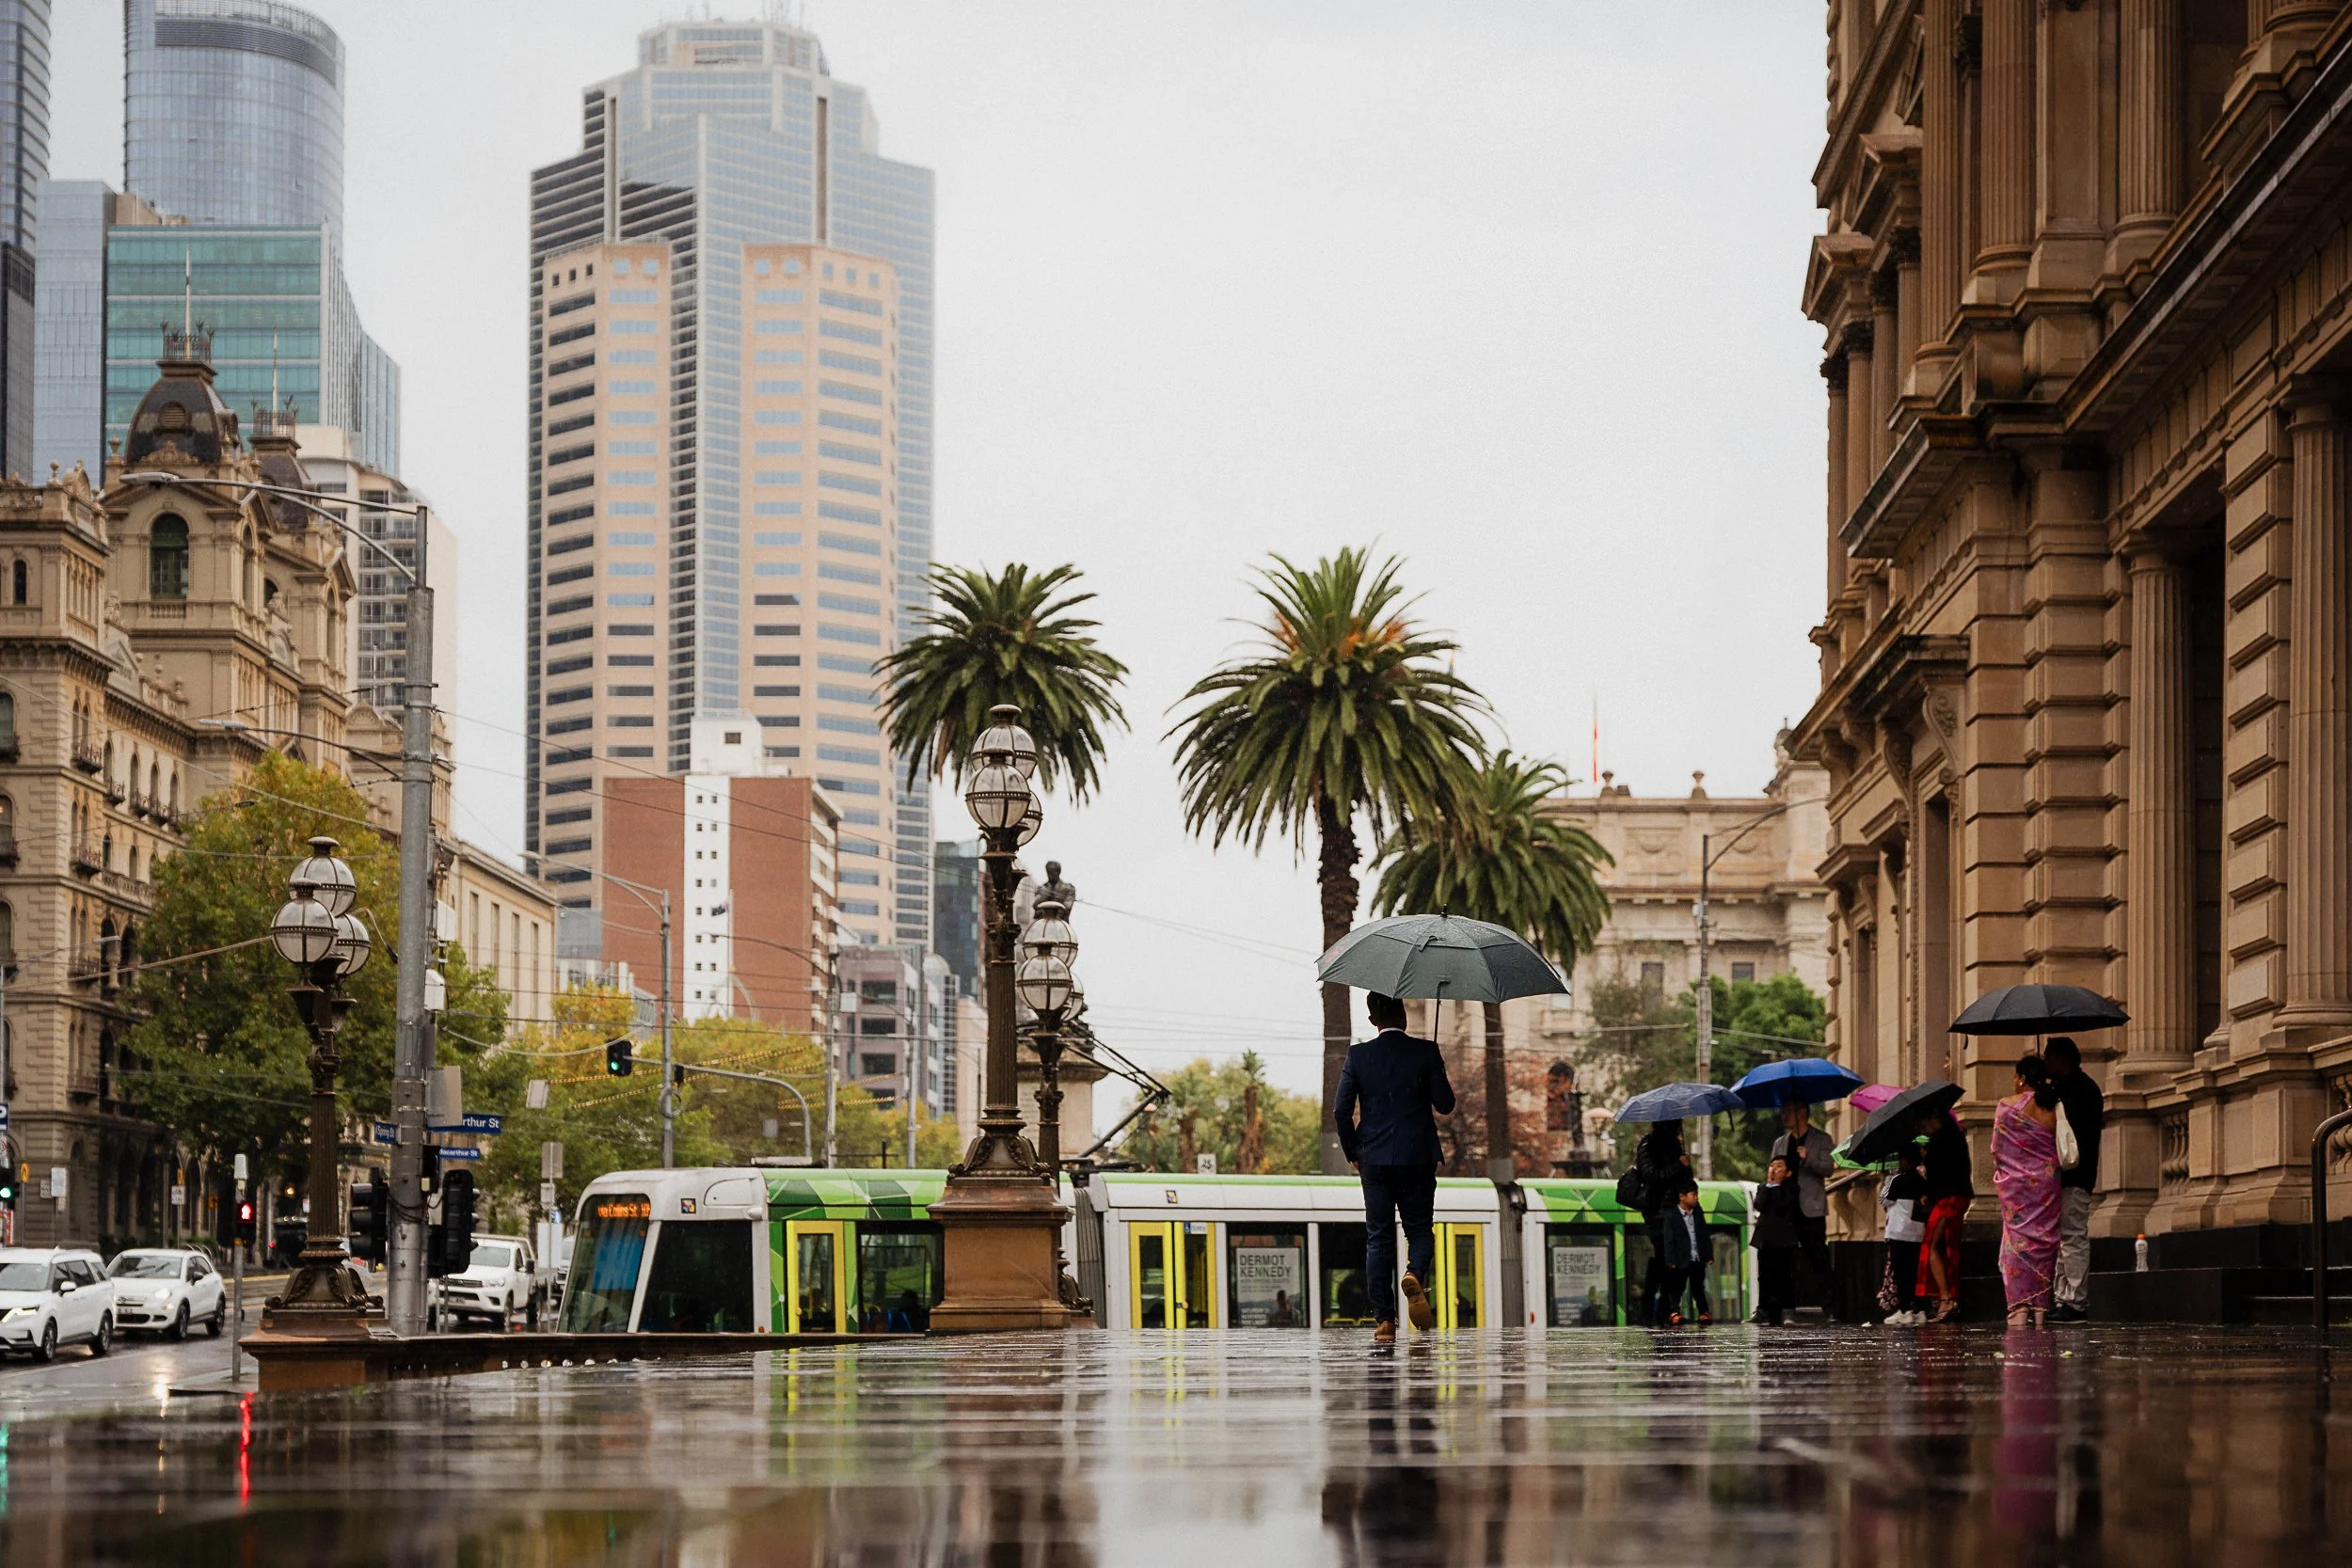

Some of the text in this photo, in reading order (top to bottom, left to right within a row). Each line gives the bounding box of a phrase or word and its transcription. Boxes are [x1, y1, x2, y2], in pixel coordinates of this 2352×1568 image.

[462, 1117, 500, 1129] rthur St
[1239, 1254, 1285, 1266] DERMOT
[1556, 1253, 1596, 1264] DERMOT
[1239, 1266, 1292, 1277] KENNEDY
[1556, 1264, 1601, 1275] KENNEDY
